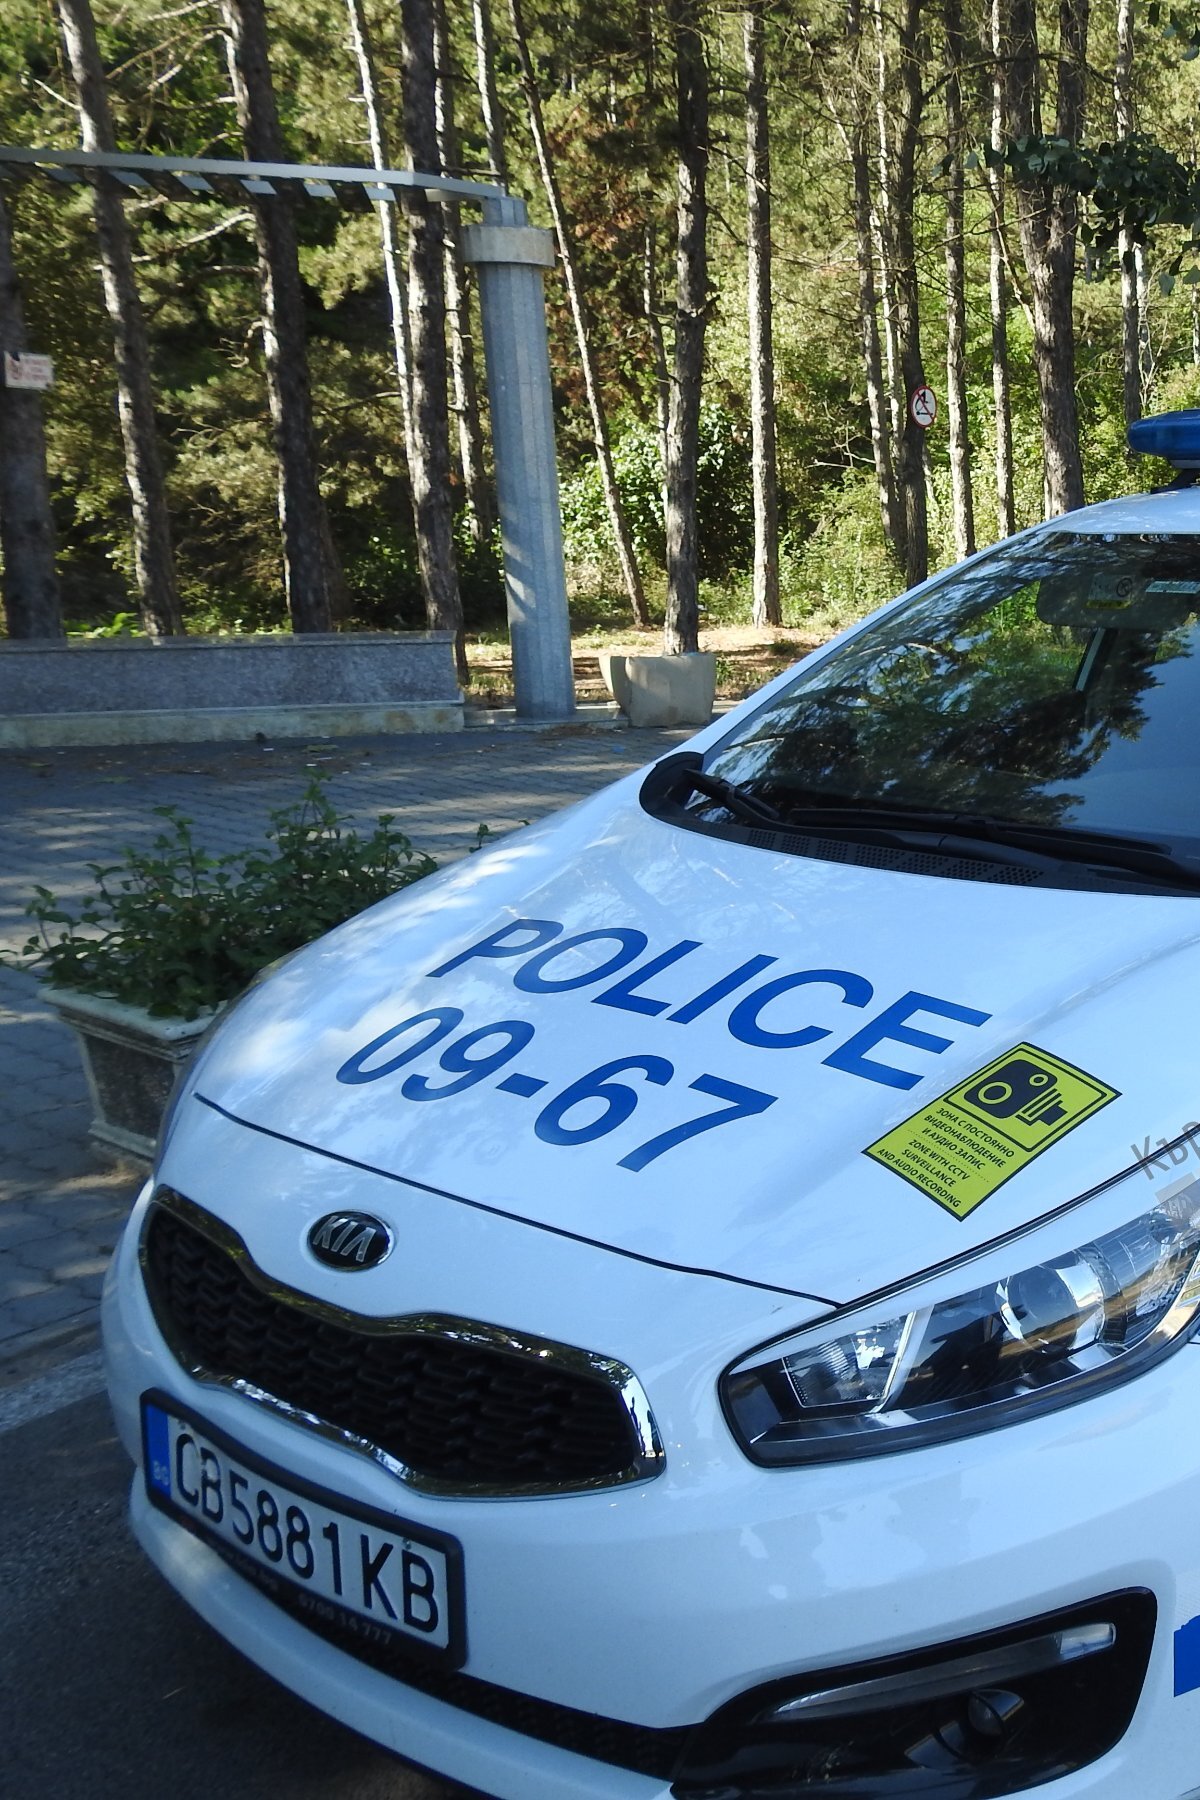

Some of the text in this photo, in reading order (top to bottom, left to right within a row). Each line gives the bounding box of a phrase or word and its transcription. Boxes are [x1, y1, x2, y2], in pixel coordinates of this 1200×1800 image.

[426, 918, 993, 1090] POLICE
[336, 1006, 778, 1173] 09-67
[924, 1115, 1006, 1168] ВИДЕОНАБЛЮДЕНИЕ
[928, 1132, 958, 1151] АУДИО
[955, 1148, 986, 1170] ЗАПИС
[936, 1108, 959, 1123] ЗОНА
[963, 1123, 1015, 1158] ПОСТОЯННО
[877, 1148, 961, 1208] AND AUDIO RECORDING
[901, 1149, 957, 1188] SURVEILLANCE
[908, 1139, 971, 1180] ZONE WITH CCTV
[312, 1215, 377, 1263] KIA
